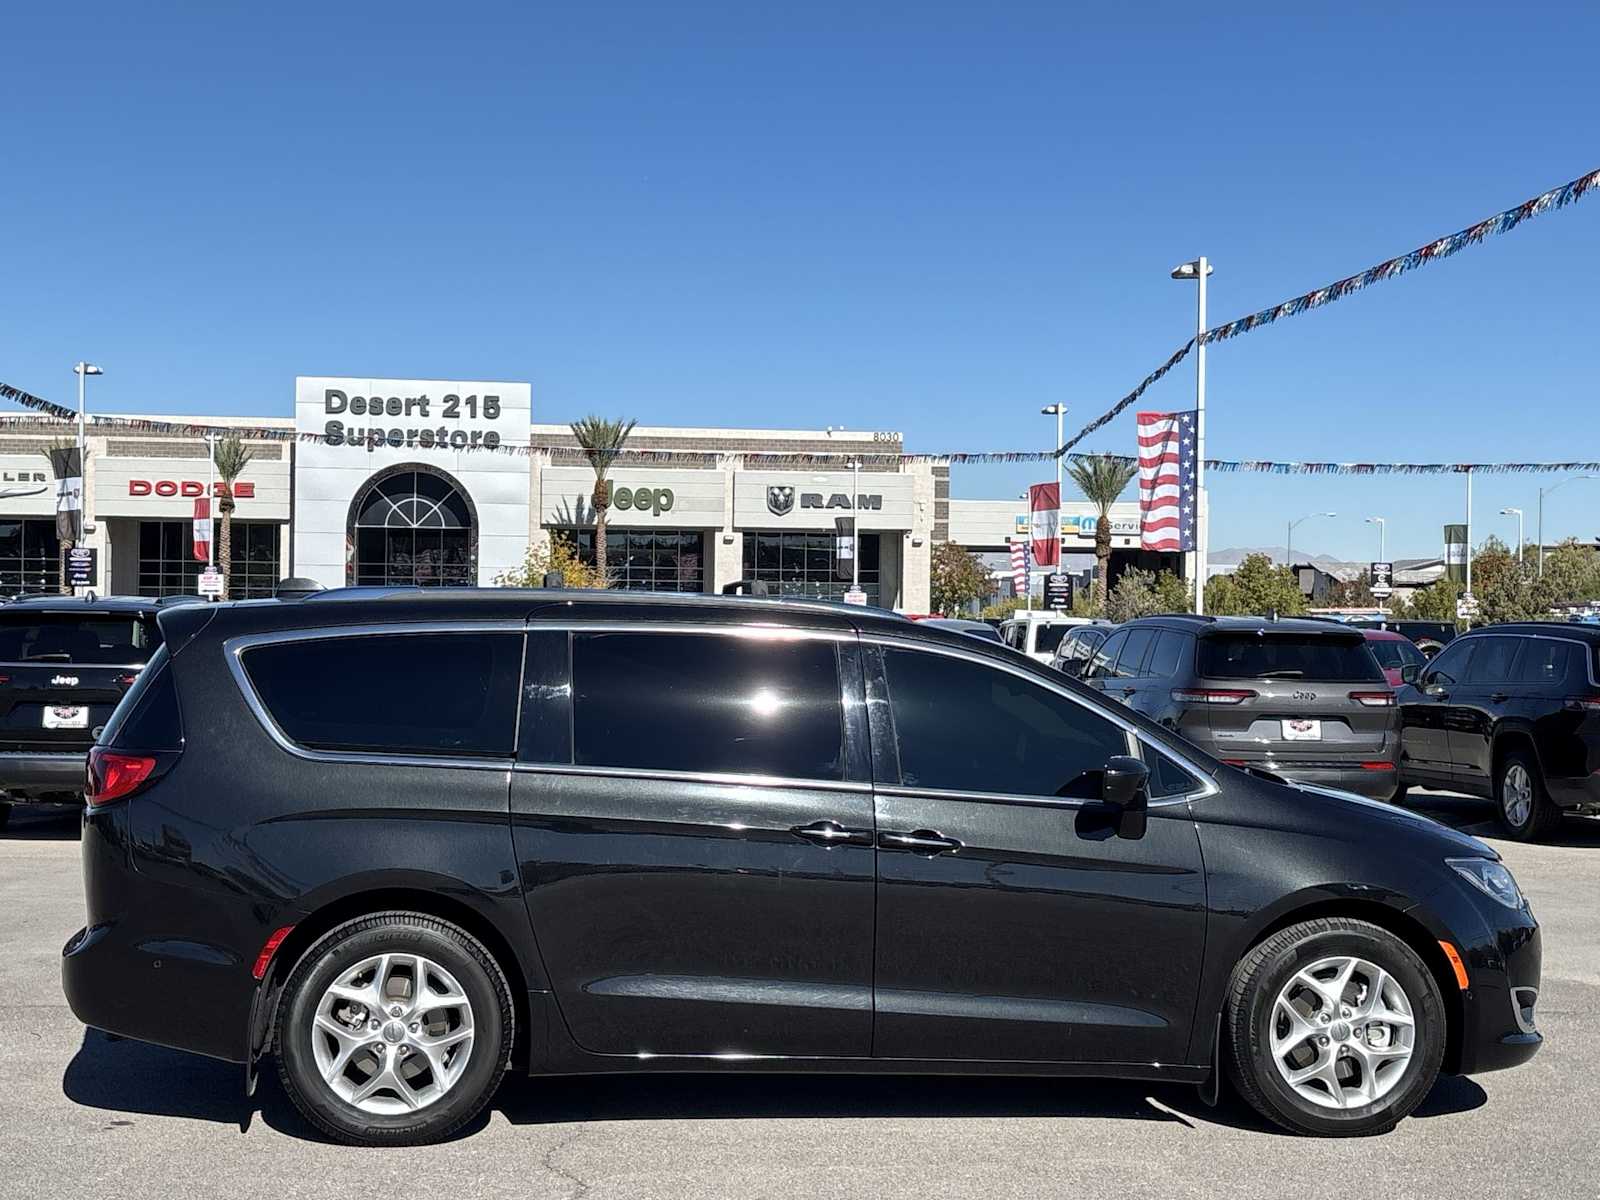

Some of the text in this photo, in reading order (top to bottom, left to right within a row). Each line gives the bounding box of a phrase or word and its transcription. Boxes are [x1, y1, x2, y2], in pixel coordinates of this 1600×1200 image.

[325, 389, 501, 419] Desert 215
[324, 420, 501, 452] Superstore
[873, 432, 899, 442] 8030
[800, 493, 882, 510] RAM
[51, 675, 79, 686] Jeep
[1292, 690, 1317, 700] Jeep
